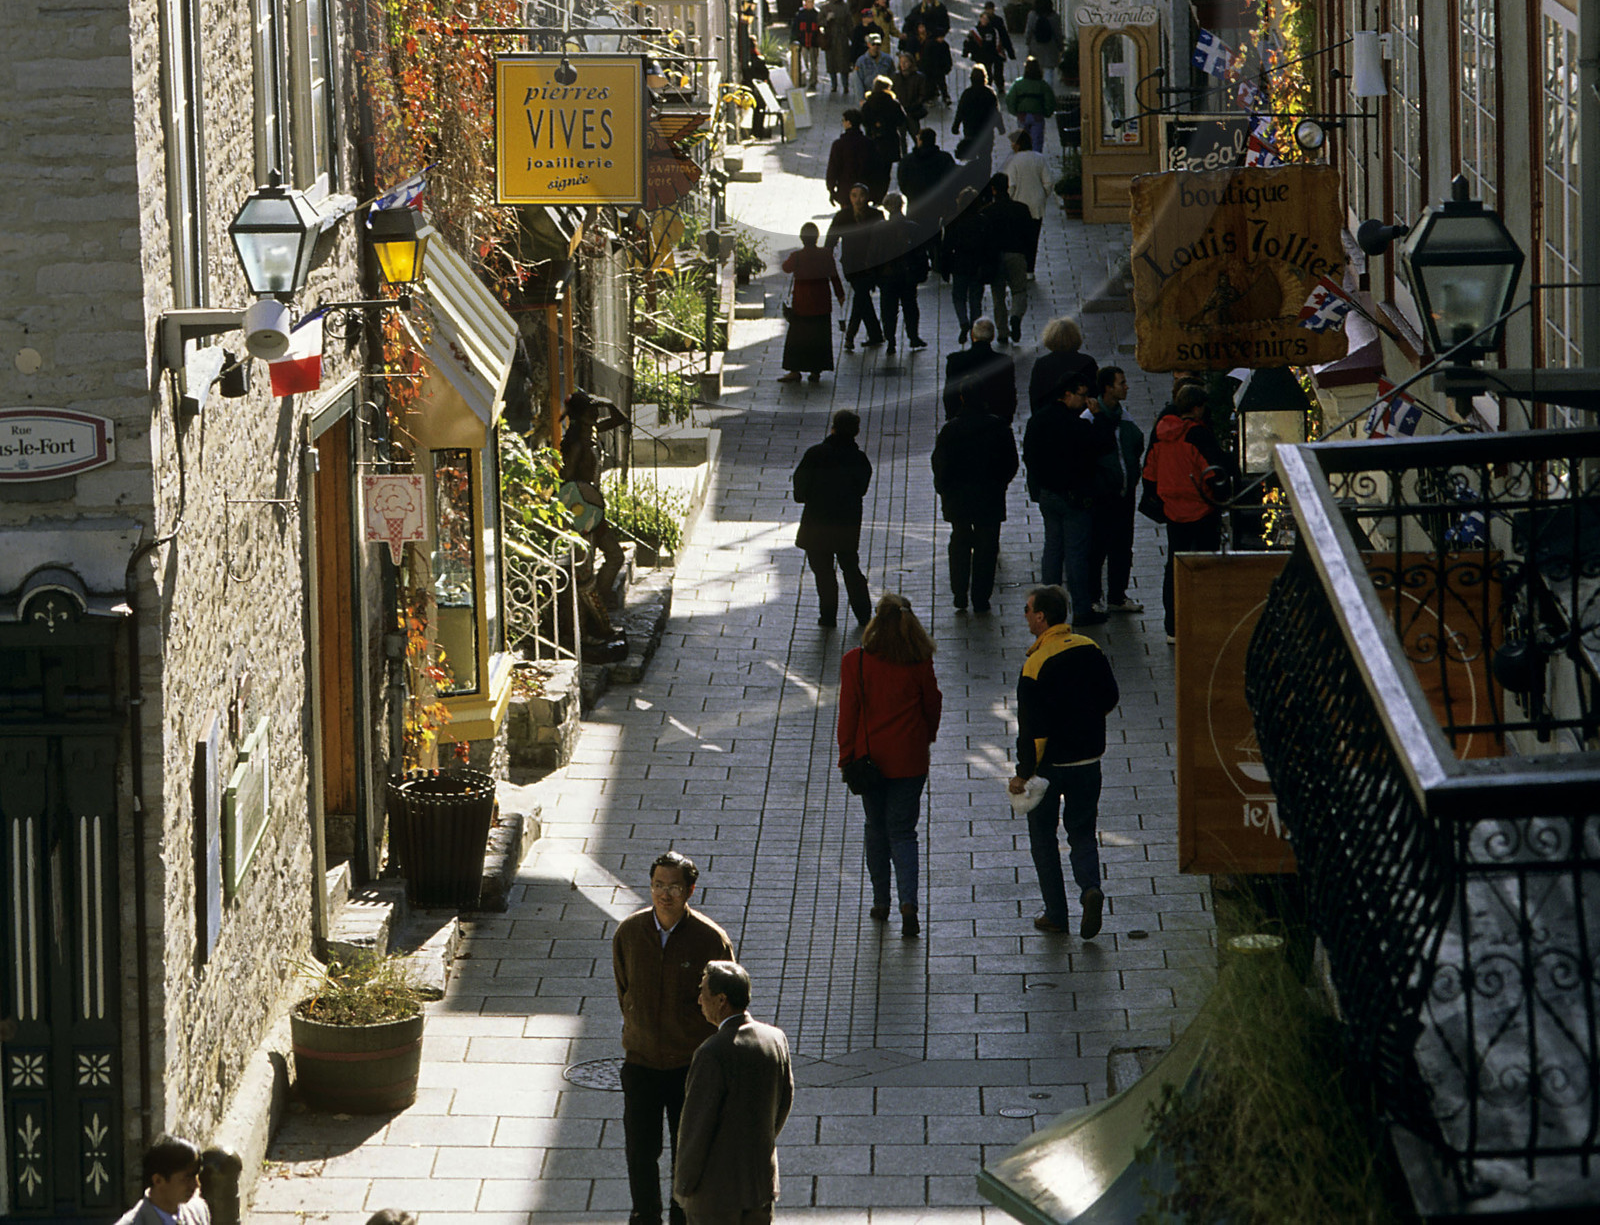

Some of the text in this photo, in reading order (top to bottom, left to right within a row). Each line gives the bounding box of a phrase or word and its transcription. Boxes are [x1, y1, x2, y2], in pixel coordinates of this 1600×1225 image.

[523, 81, 613, 105] pierres
[526, 109, 613, 149] VIVES
[526, 157, 613, 172] joaillerie
[547, 173, 591, 191] signée
[1180, 181, 1289, 211] boutique
[1134, 227, 1237, 285] Louis
[1177, 331, 1309, 362] souvenirs
[11, 425, 32, 435] Rue
[0, 438, 76, 456] s-le-Fort
